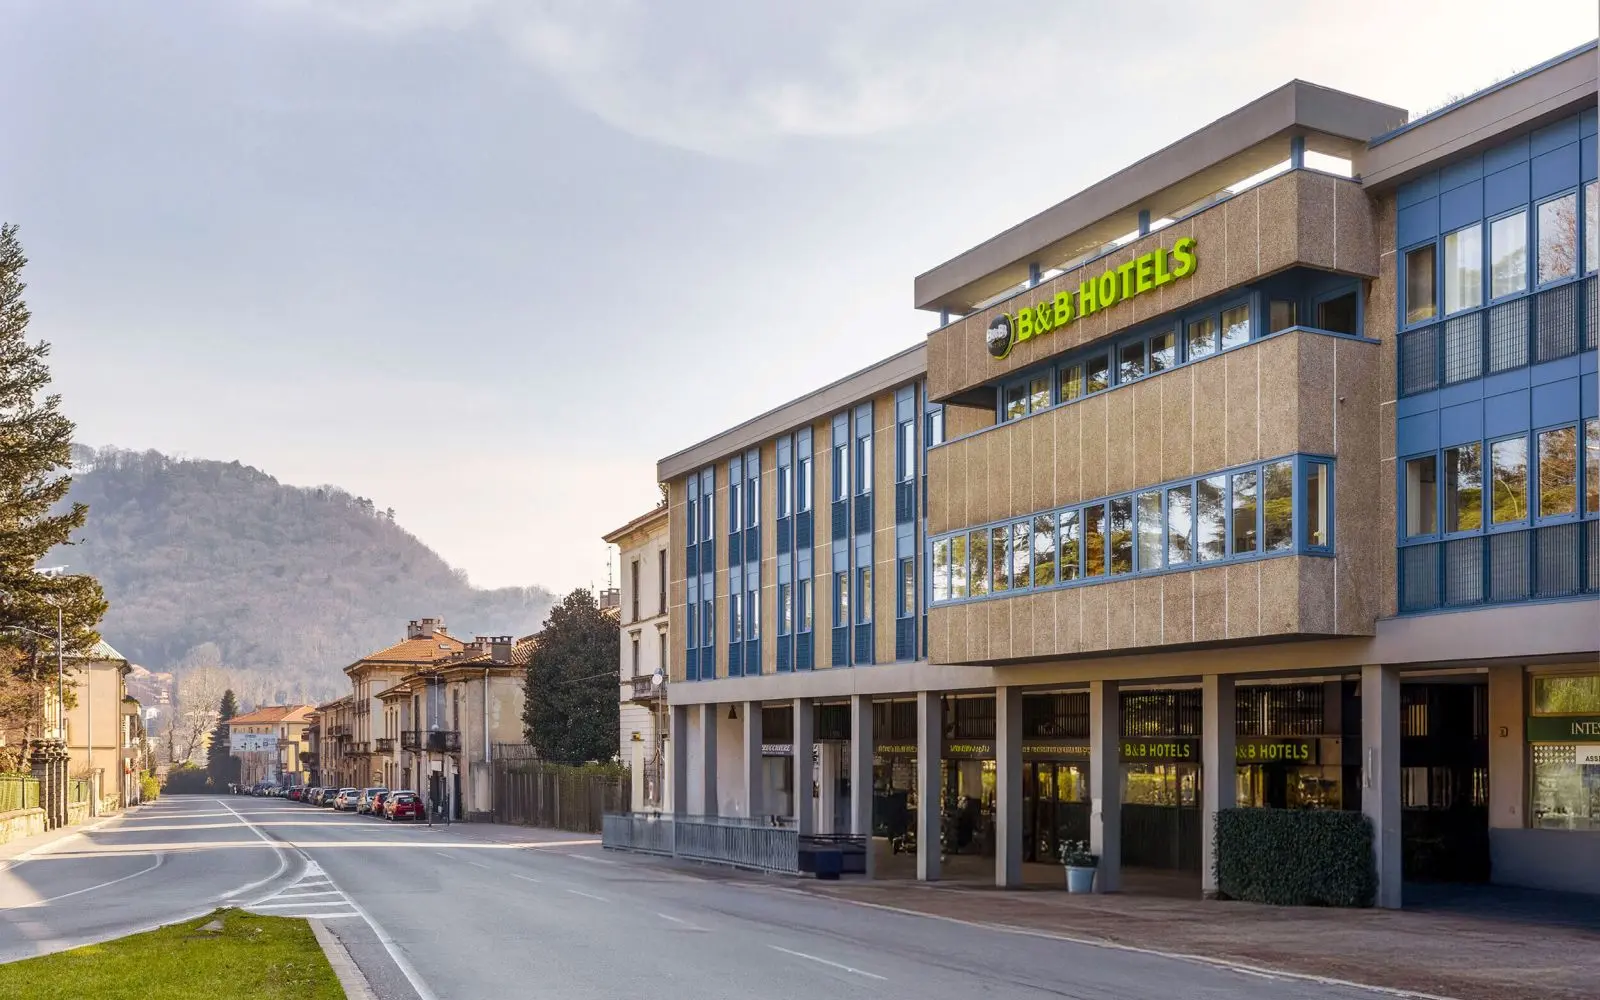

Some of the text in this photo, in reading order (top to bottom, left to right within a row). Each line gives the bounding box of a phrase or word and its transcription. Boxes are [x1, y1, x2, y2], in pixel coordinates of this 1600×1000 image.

[1018, 237, 1197, 341] B&B HOTELS
[1125, 743, 1190, 758] B&B HOTELS
[1235, 744, 1309, 759] &B HOTELS
